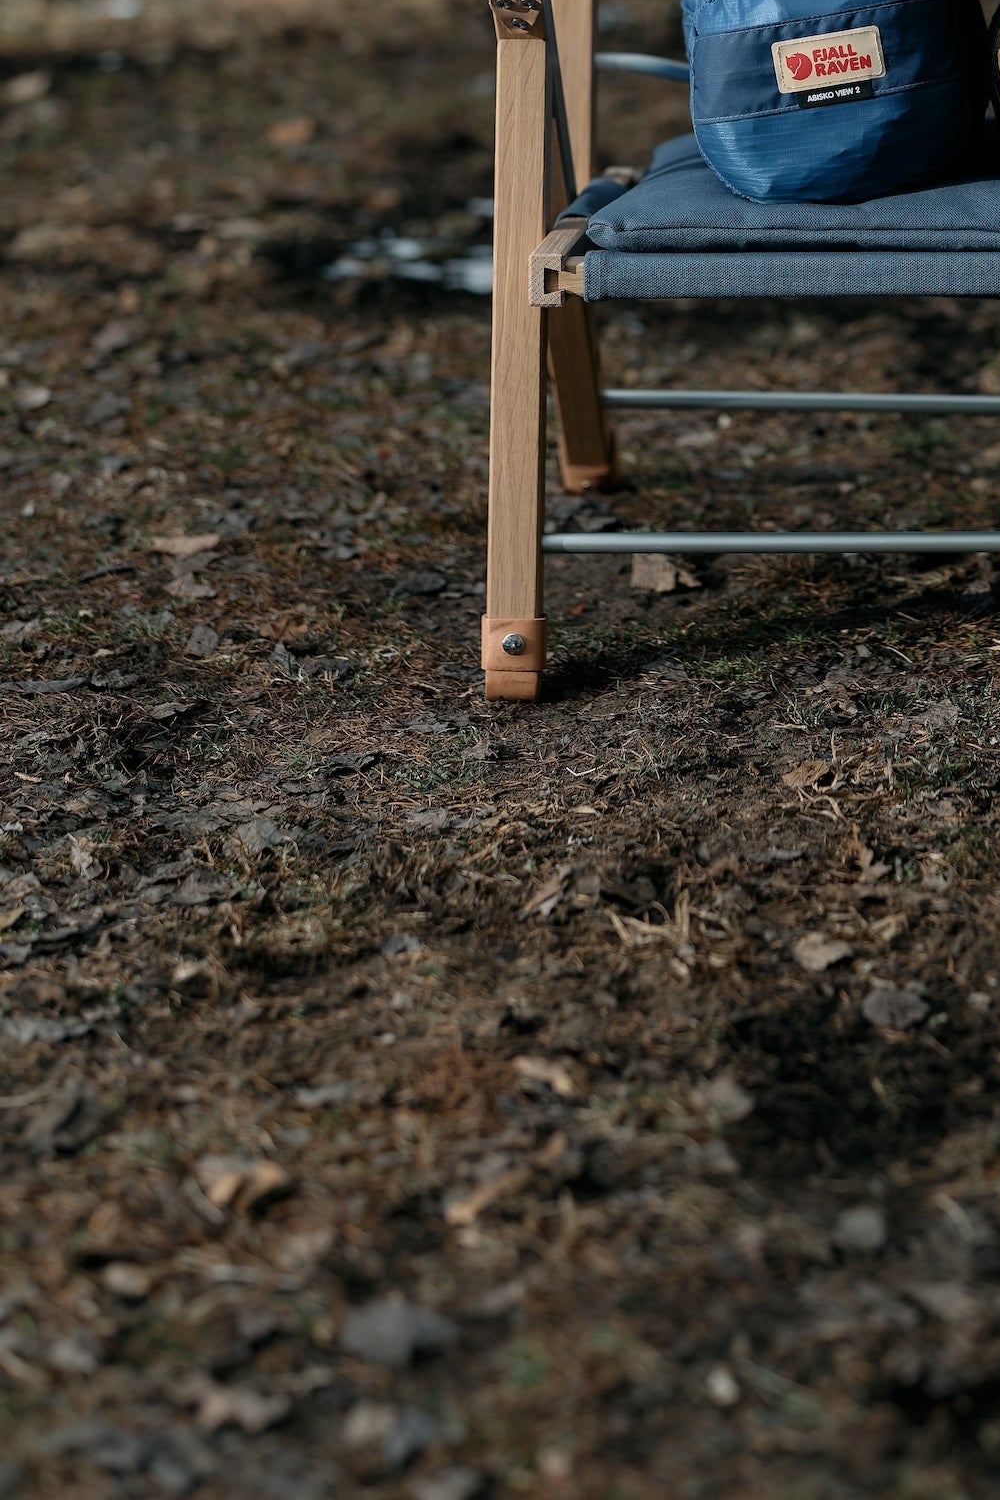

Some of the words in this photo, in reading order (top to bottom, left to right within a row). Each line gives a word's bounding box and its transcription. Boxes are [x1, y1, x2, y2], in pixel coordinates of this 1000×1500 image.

[812, 44, 857, 62] FJÄLL
[814, 55, 872, 77] RÄVEN
[807, 91, 834, 102] ABISKO
[835, 87, 854, 98] VIEW
